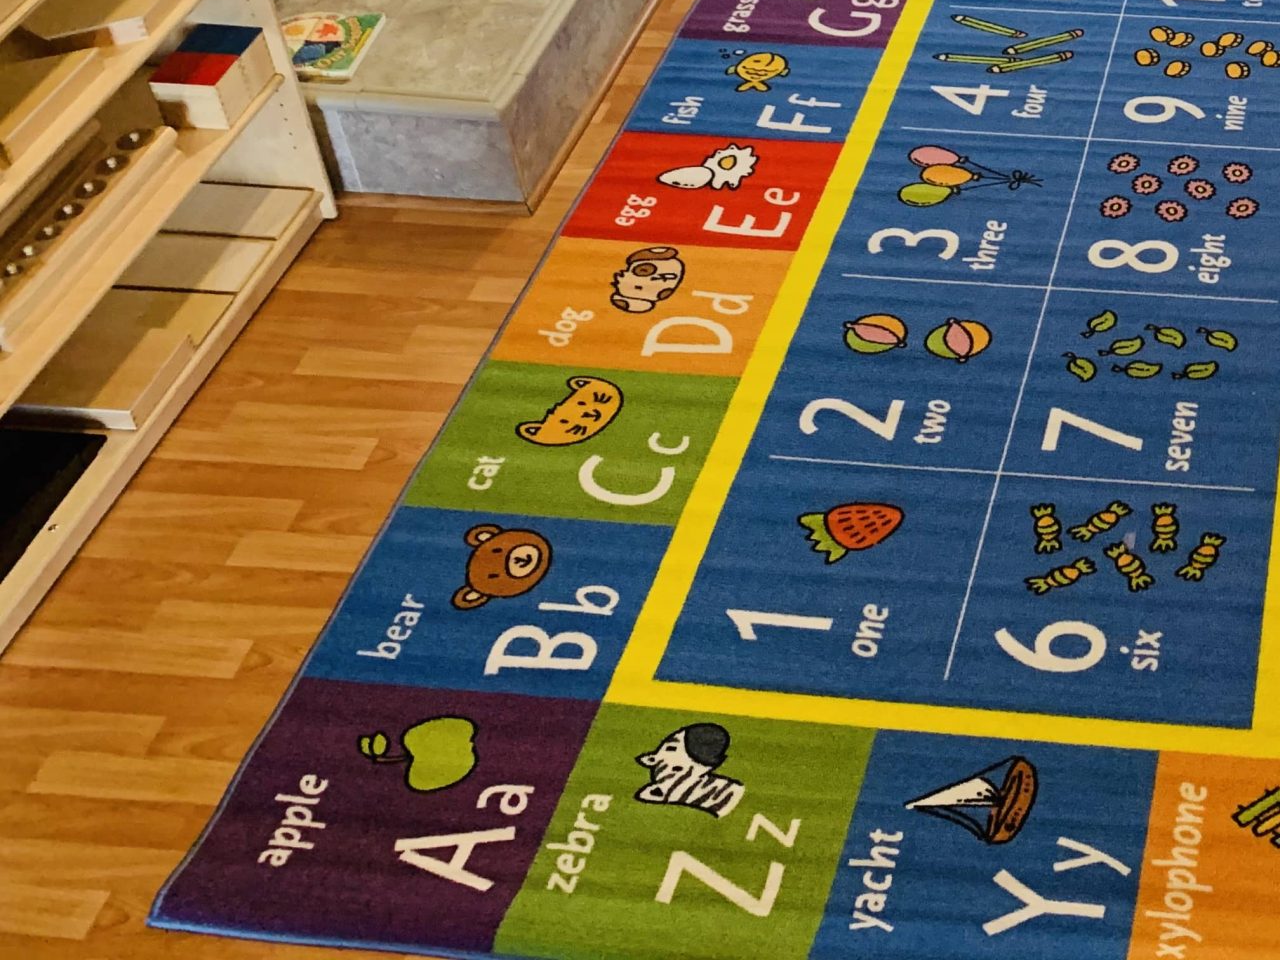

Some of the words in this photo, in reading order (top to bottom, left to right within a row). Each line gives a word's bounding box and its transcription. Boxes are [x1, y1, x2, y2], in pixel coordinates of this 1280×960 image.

[662, 96, 704, 124] fish
[756, 94, 841, 133] Ff
[931, 84, 1010, 115] 4
[1011, 85, 1047, 118] four
[1124, 96, 1205, 123] 9
[1224, 96, 1247, 130] nine
[615, 194, 657, 226] egg
[703, 186, 800, 237] Ee
[868, 228, 959, 260] 3
[962, 220, 1007, 270] three
[1088, 240, 1179, 273] 8
[1189, 234, 1231, 283] eight
[538, 307, 594, 346] dog
[642, 290, 754, 357] Dd
[799, 398, 905, 440] 2
[914, 400, 951, 443] two
[1041, 407, 1143, 451] 7
[1165, 402, 1198, 471] seven
[468, 456, 505, 490] cat
[579, 432, 689, 505] Cc
[357, 594, 424, 659] bear
[484, 585, 619, 675] Bb
[726, 609, 833, 640] 1
[852, 604, 888, 657] one
[994, 621, 1106, 672] 6
[1120, 630, 1162, 671] six
[258, 775, 328, 866] apple
[395, 784, 534, 891] Aa
[546, 794, 612, 893] zebra
[655, 812, 801, 917] Zz
[848, 829, 903, 932] yacht
[983, 837, 1131, 936] Yy
[1145, 782, 1213, 959] xylophone
